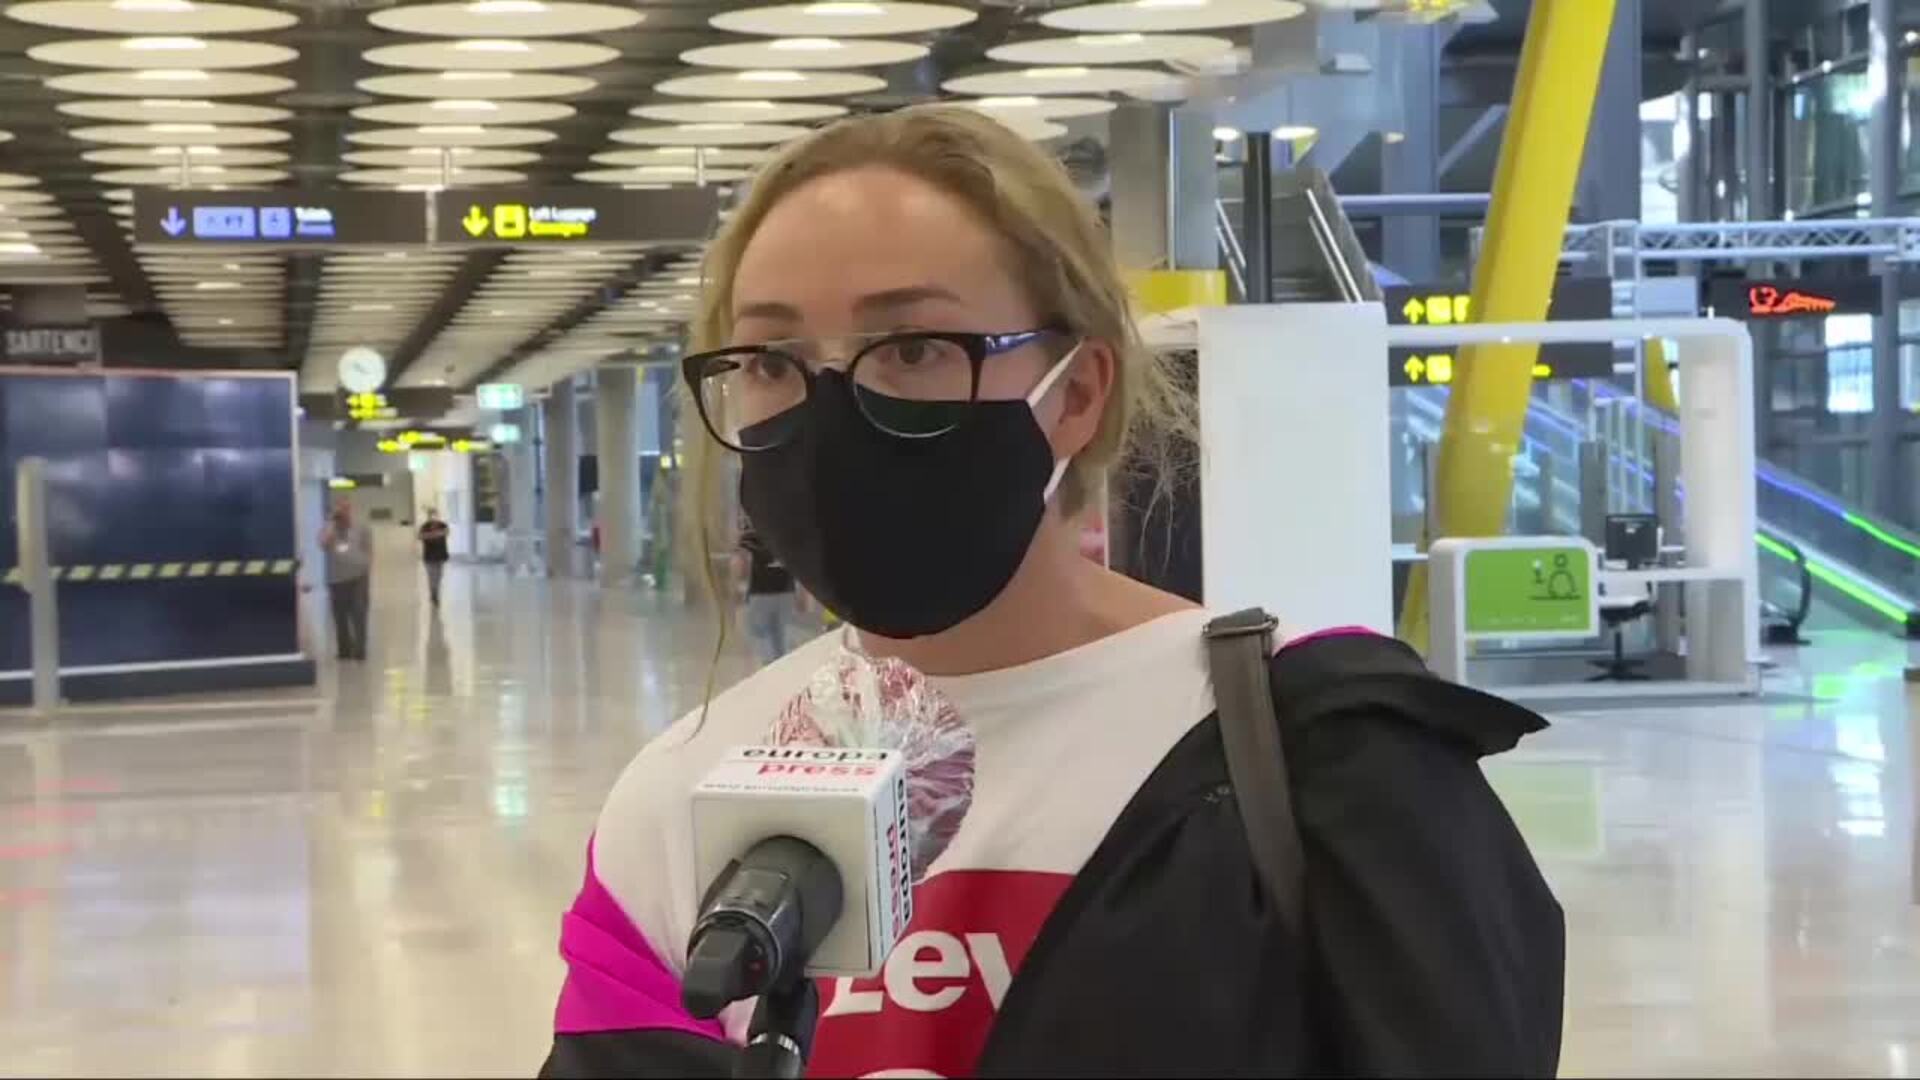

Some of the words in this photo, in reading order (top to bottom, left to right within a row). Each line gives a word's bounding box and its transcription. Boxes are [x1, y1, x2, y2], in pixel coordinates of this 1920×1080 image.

[743, 749, 889, 761] europa
[757, 764, 877, 776] press
[898, 779, 911, 922] europa
